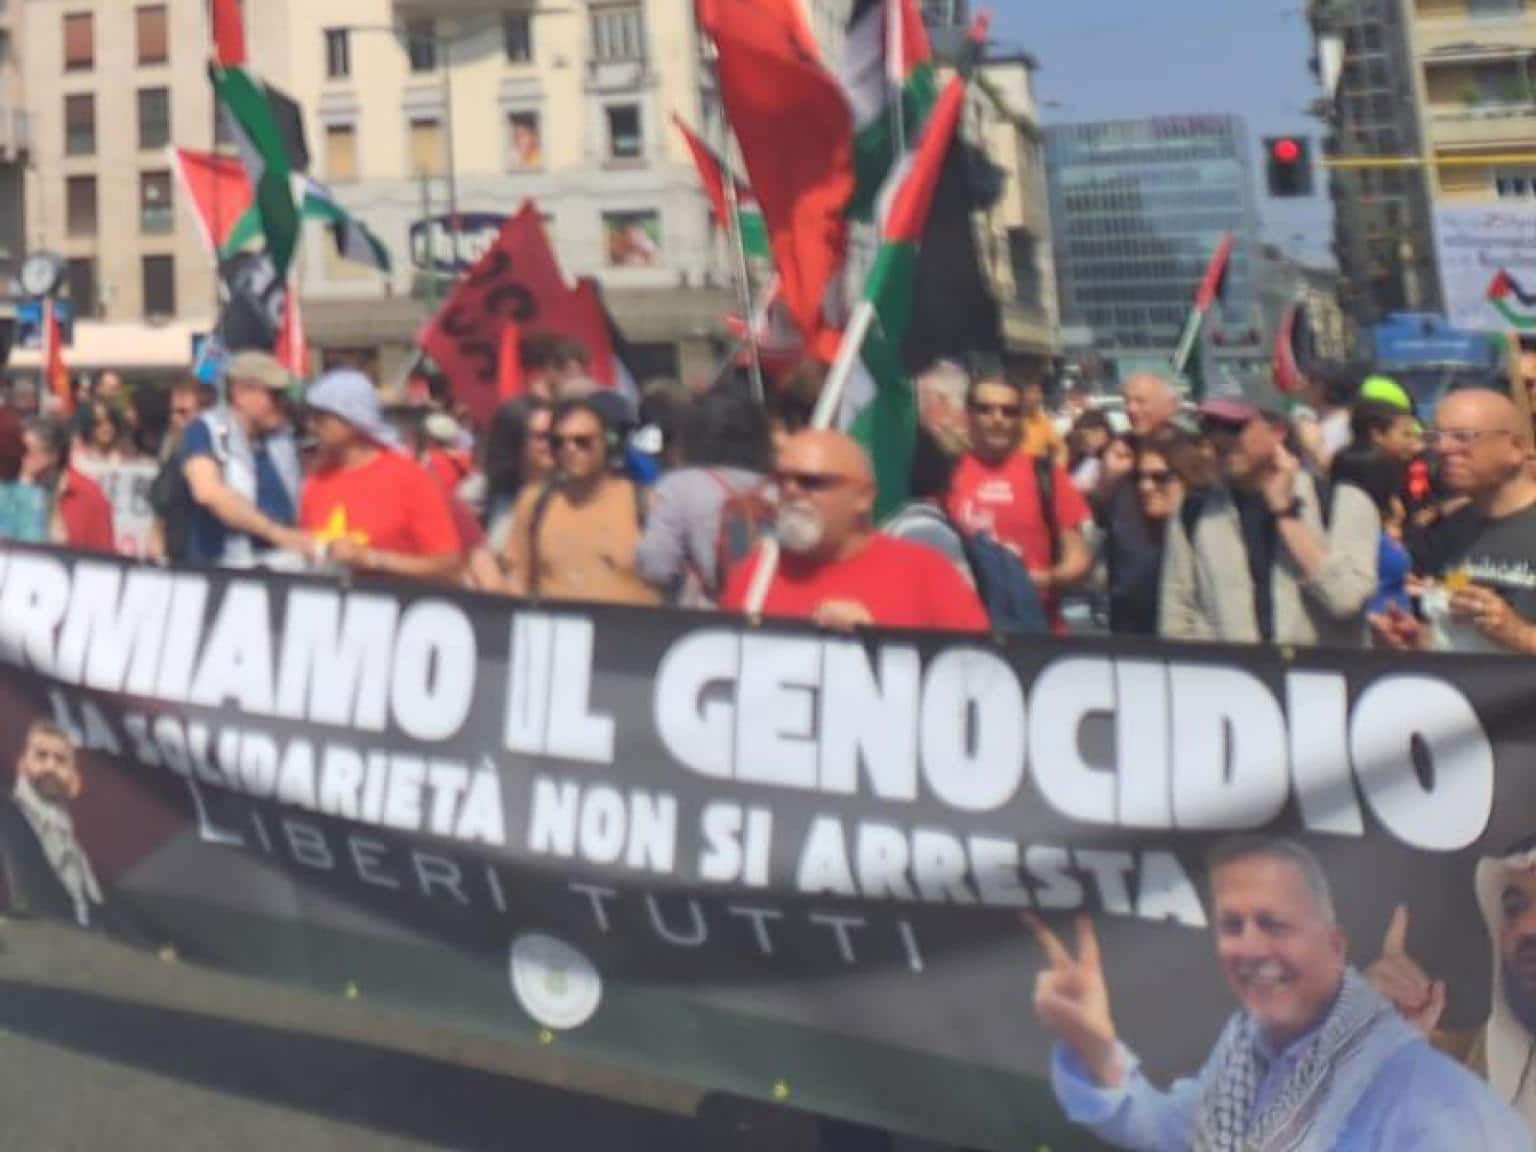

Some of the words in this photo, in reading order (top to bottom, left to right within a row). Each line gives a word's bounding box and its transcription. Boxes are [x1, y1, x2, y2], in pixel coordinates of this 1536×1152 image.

[50, 691, 122, 757] LA
[123, 712, 506, 847] SOLIDARIETÀ
[528, 776, 677, 874] NON
[700, 799, 772, 887] SI
[797, 814, 1209, 929] ARRESTA
[503, 611, 616, 764] IL
[653, 628, 1495, 852] GENOCIDIO
[185, 778, 507, 912] LIBERI
[569, 881, 923, 973] TUTTI
